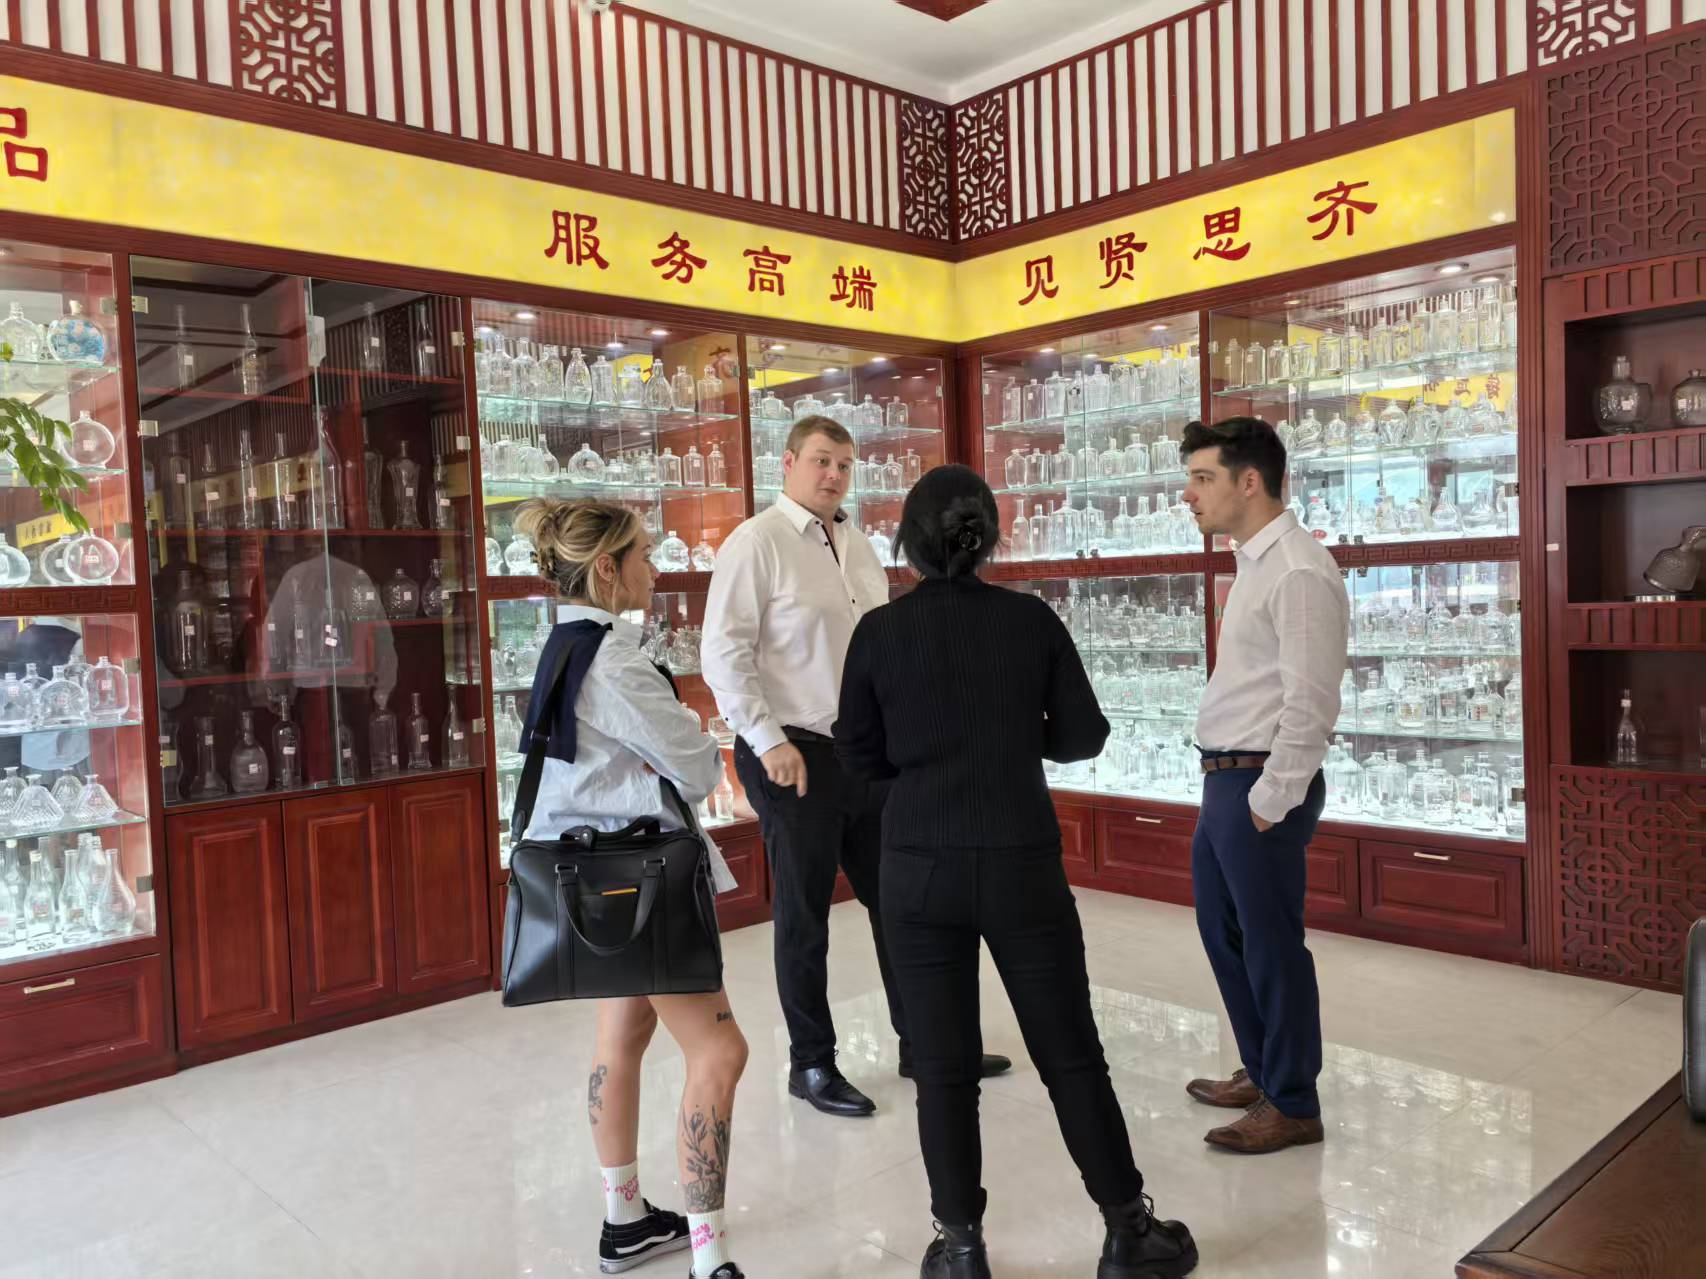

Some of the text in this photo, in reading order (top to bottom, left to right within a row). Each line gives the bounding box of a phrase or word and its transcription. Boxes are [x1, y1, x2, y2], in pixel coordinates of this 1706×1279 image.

[545, 209, 878, 311] 服务高端
[1018, 180, 1378, 306] 见贤思齐
